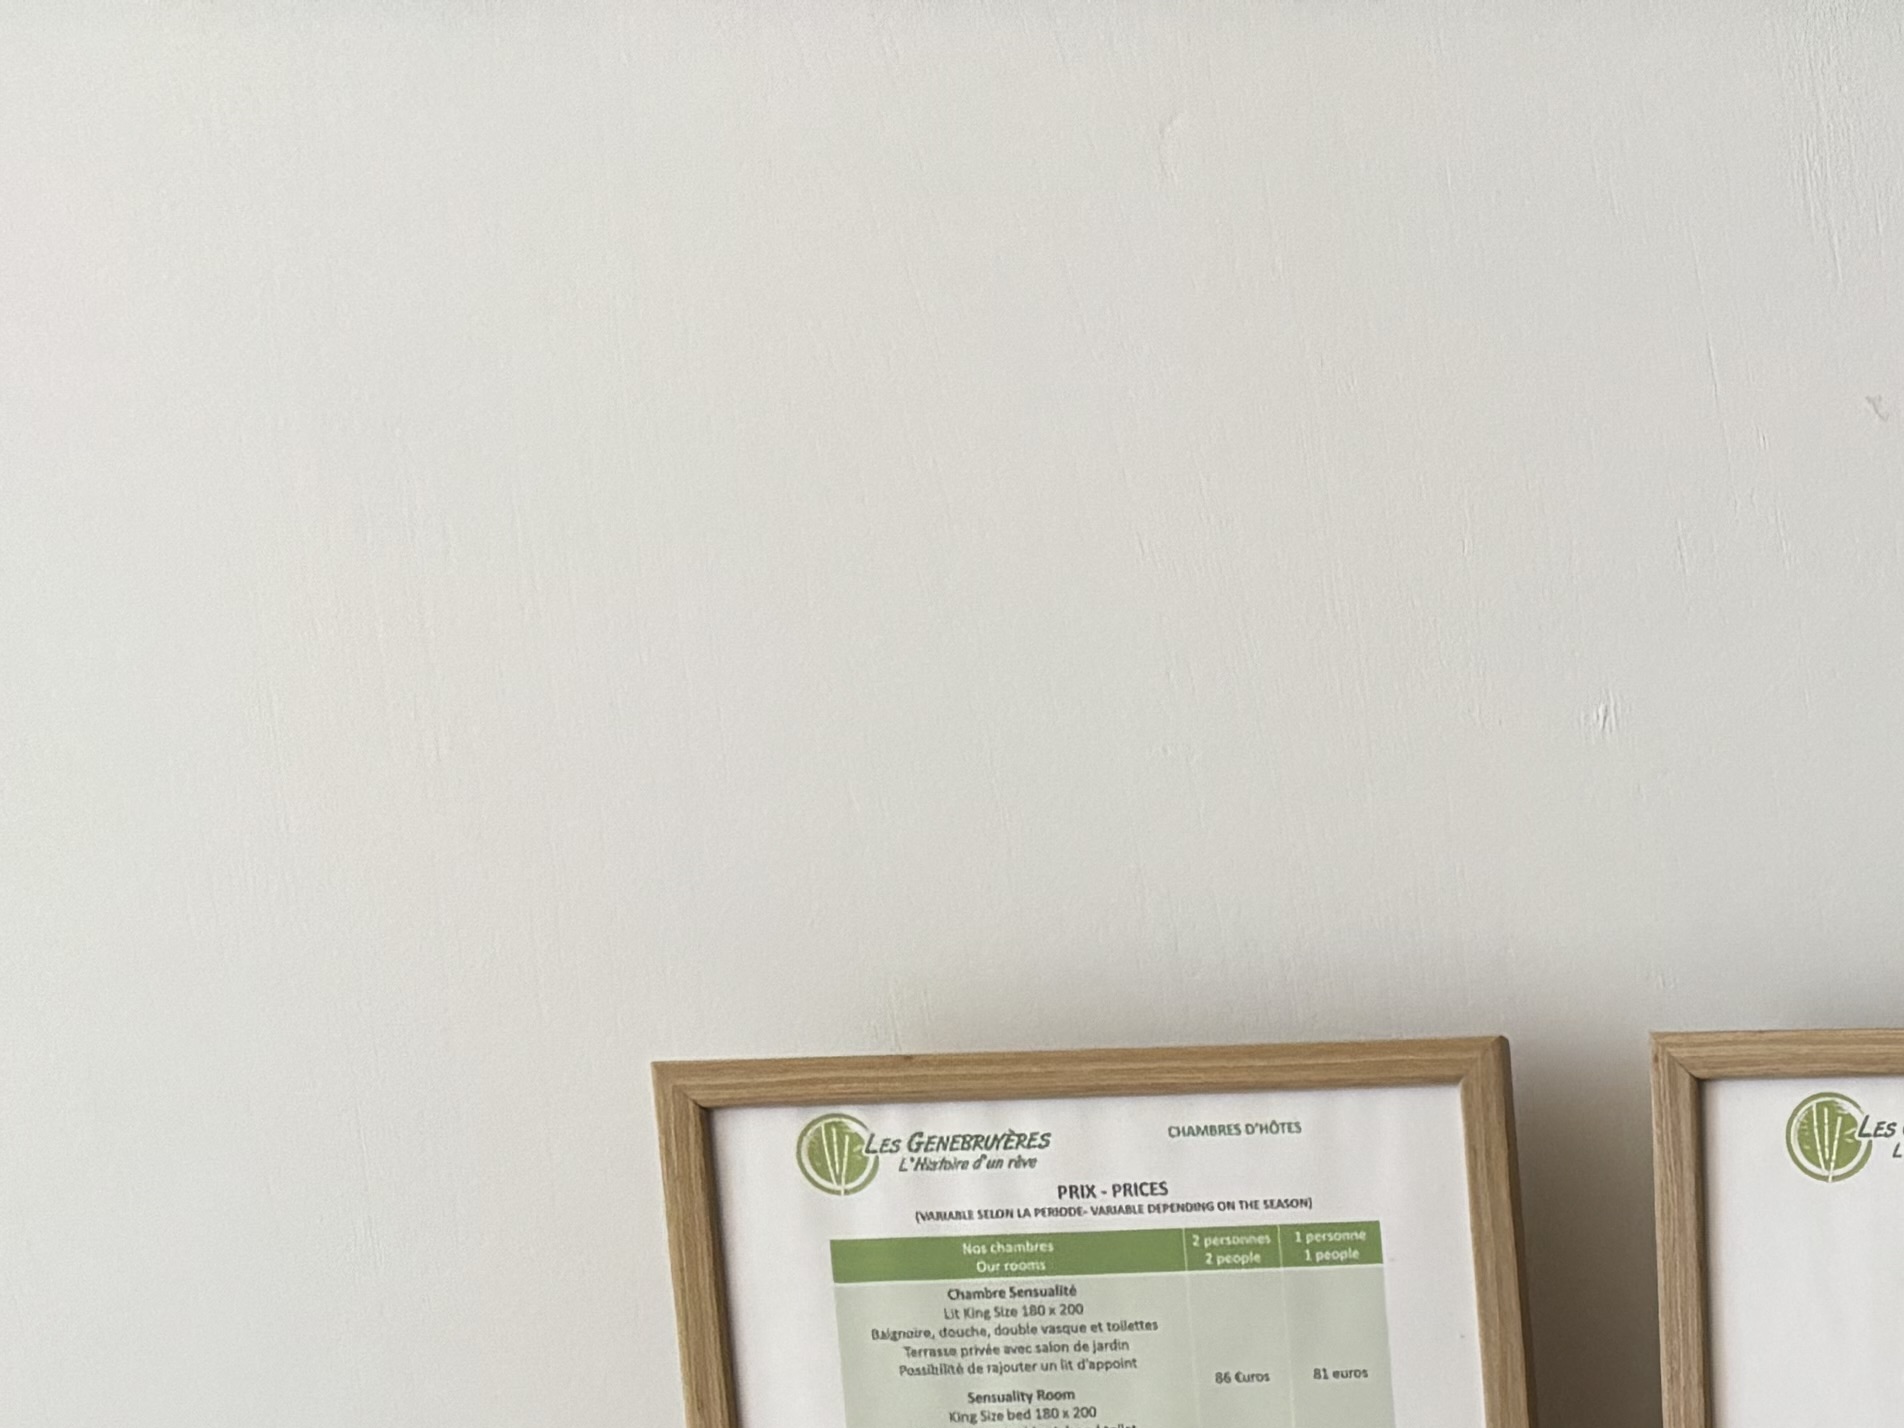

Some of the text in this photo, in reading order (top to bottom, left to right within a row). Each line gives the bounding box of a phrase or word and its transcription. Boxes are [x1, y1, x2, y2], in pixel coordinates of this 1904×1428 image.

[1057, 1184, 1096, 1199] PRIX
[1111, 1180, 1168, 1197] PRICES
[1192, 1233, 1271, 1248] 2 personnes
[1295, 1230, 1366, 1244] 1 personne
[947, 1284, 1076, 1300] Chambre Sensualité
[943, 1302, 1083, 1319] Lit King Size 180 x 200
[1313, 1367, 1368, 1379] 81 euros
[967, 1389, 1075, 1404] Sensuality Room
